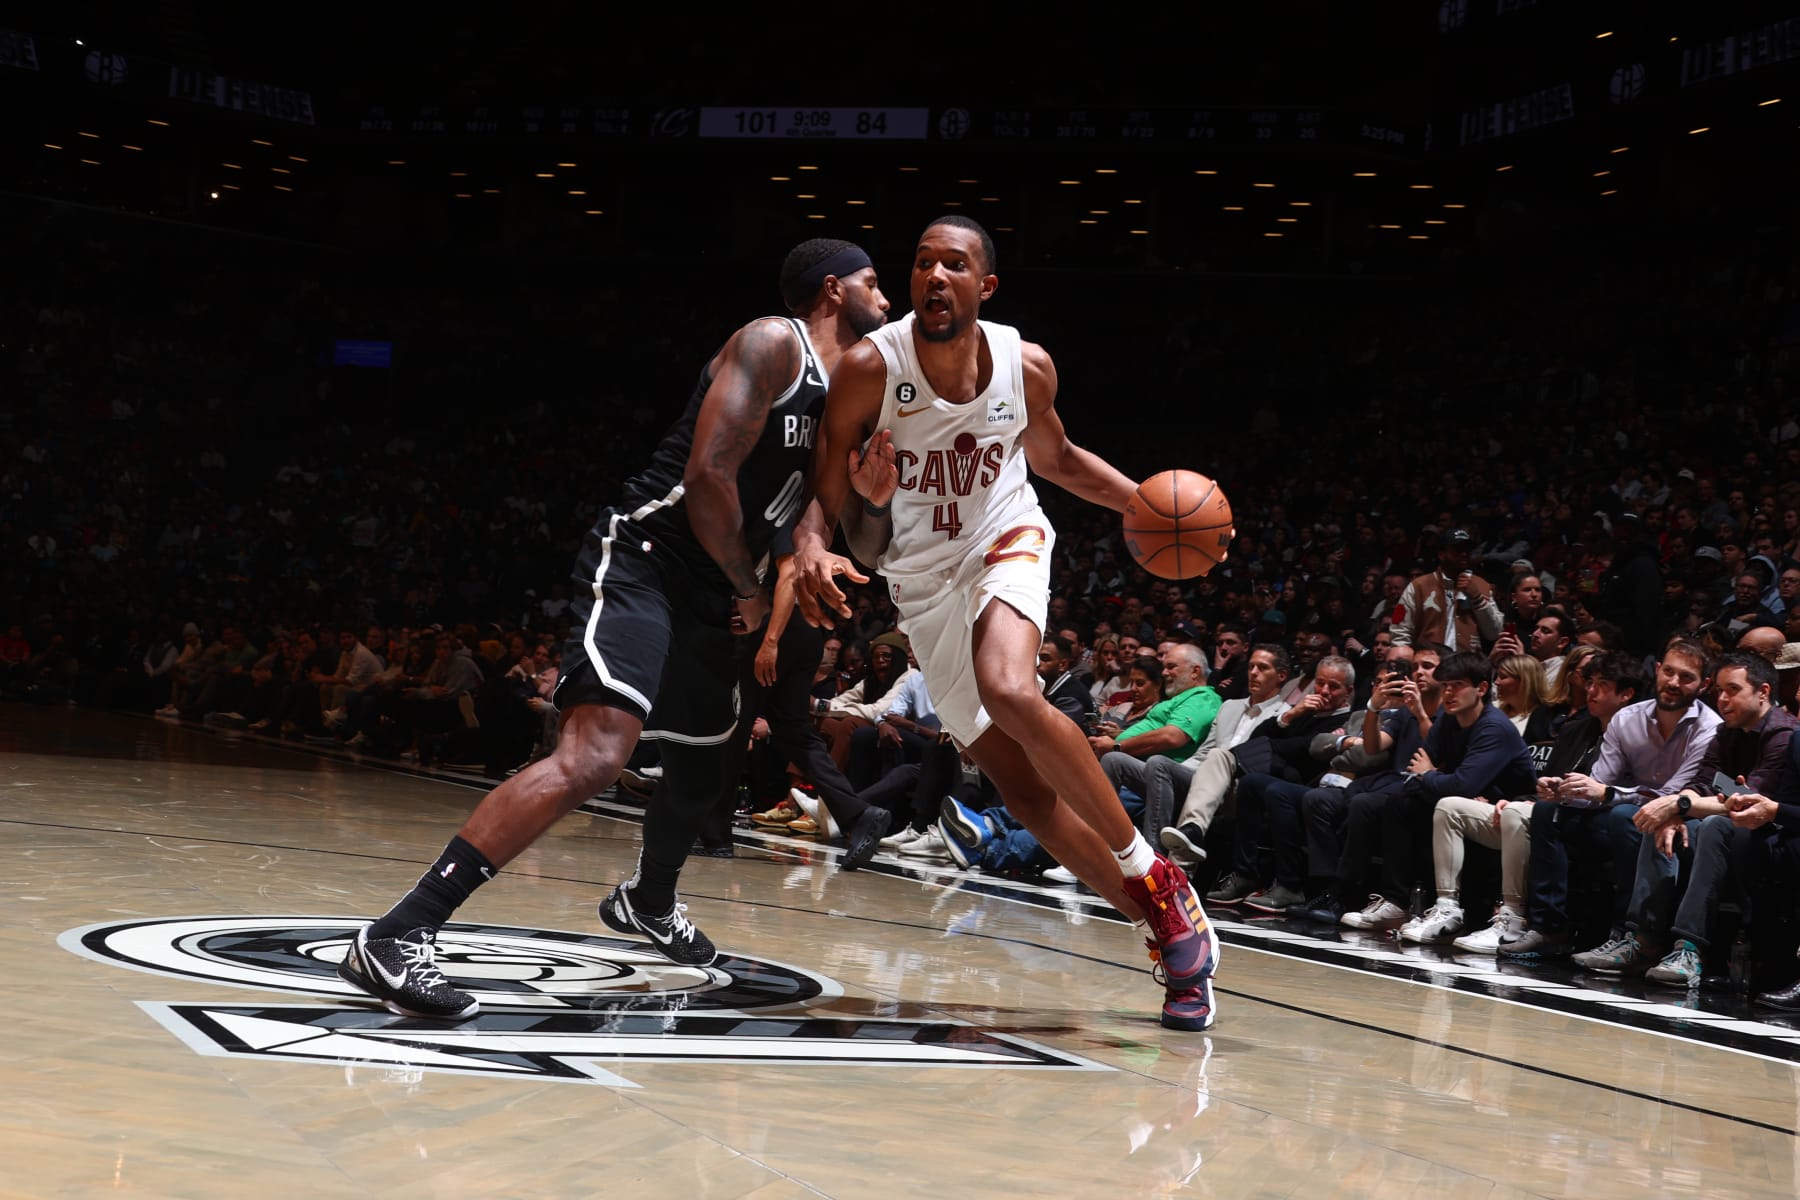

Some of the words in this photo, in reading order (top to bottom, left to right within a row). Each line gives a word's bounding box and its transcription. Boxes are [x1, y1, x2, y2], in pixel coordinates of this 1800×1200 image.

[735, 112, 776, 133] 101
[793, 111, 831, 126] 9:09
[856, 111, 887, 134] 84
[900, 385, 912, 401] 6
[988, 413, 1014, 423] CLIFFS
[896, 442, 1004, 497] CAVS
[932, 501, 962, 541] 4
